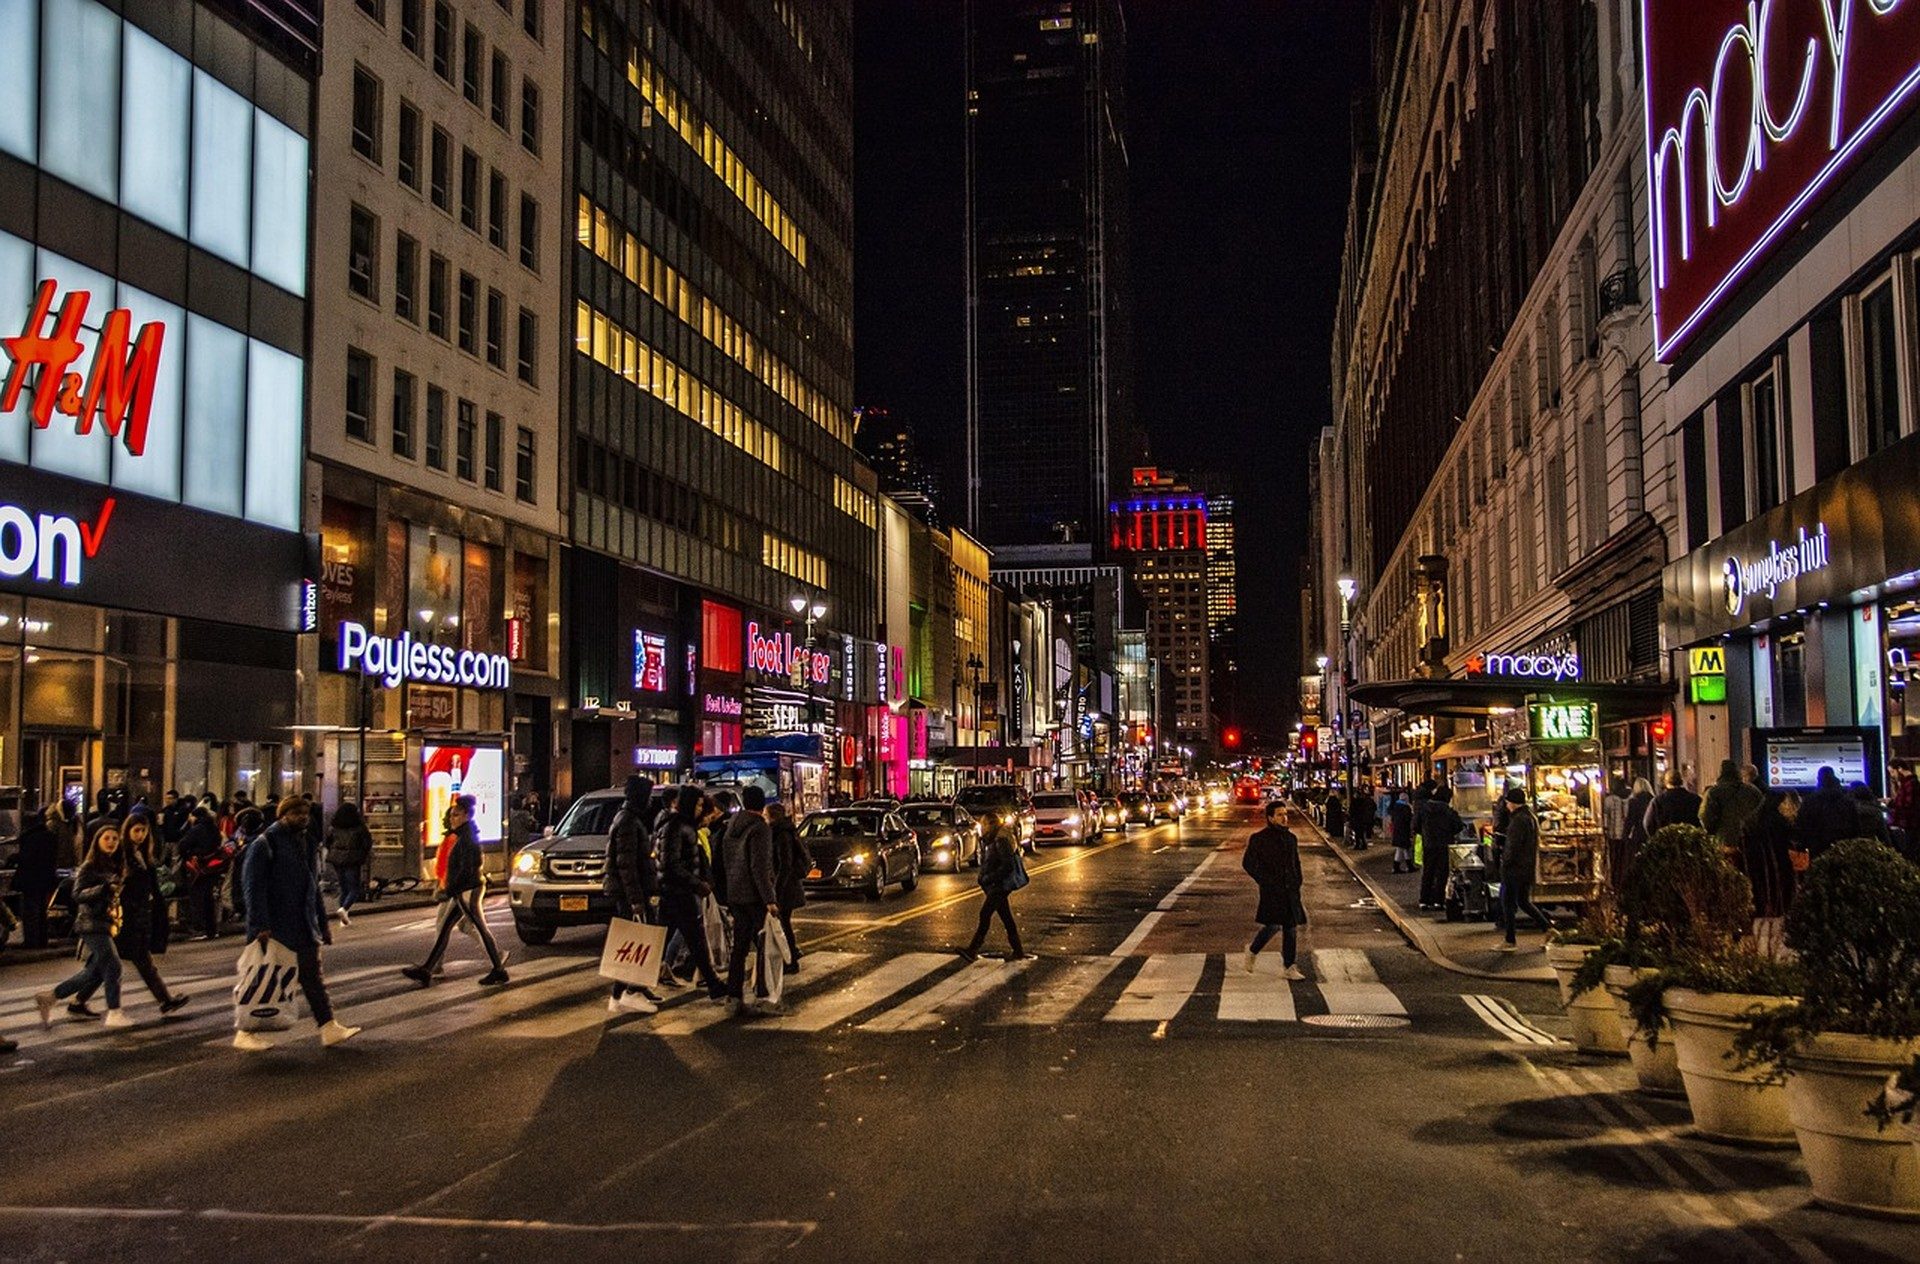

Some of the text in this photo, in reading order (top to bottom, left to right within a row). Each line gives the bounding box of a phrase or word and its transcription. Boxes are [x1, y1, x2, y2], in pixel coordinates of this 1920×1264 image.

[1653, 0, 1898, 289] macy
[0, 278, 165, 456] H&M
[1742, 522, 1828, 599] sunglass hut
[303, 583, 317, 632] verizon
[340, 620, 509, 688] Payless.com
[748, 622, 783, 674] Foot
[785, 632, 830, 684] Locer
[1013, 663, 1022, 694] KAY
[613, 939, 651, 967] H&M
